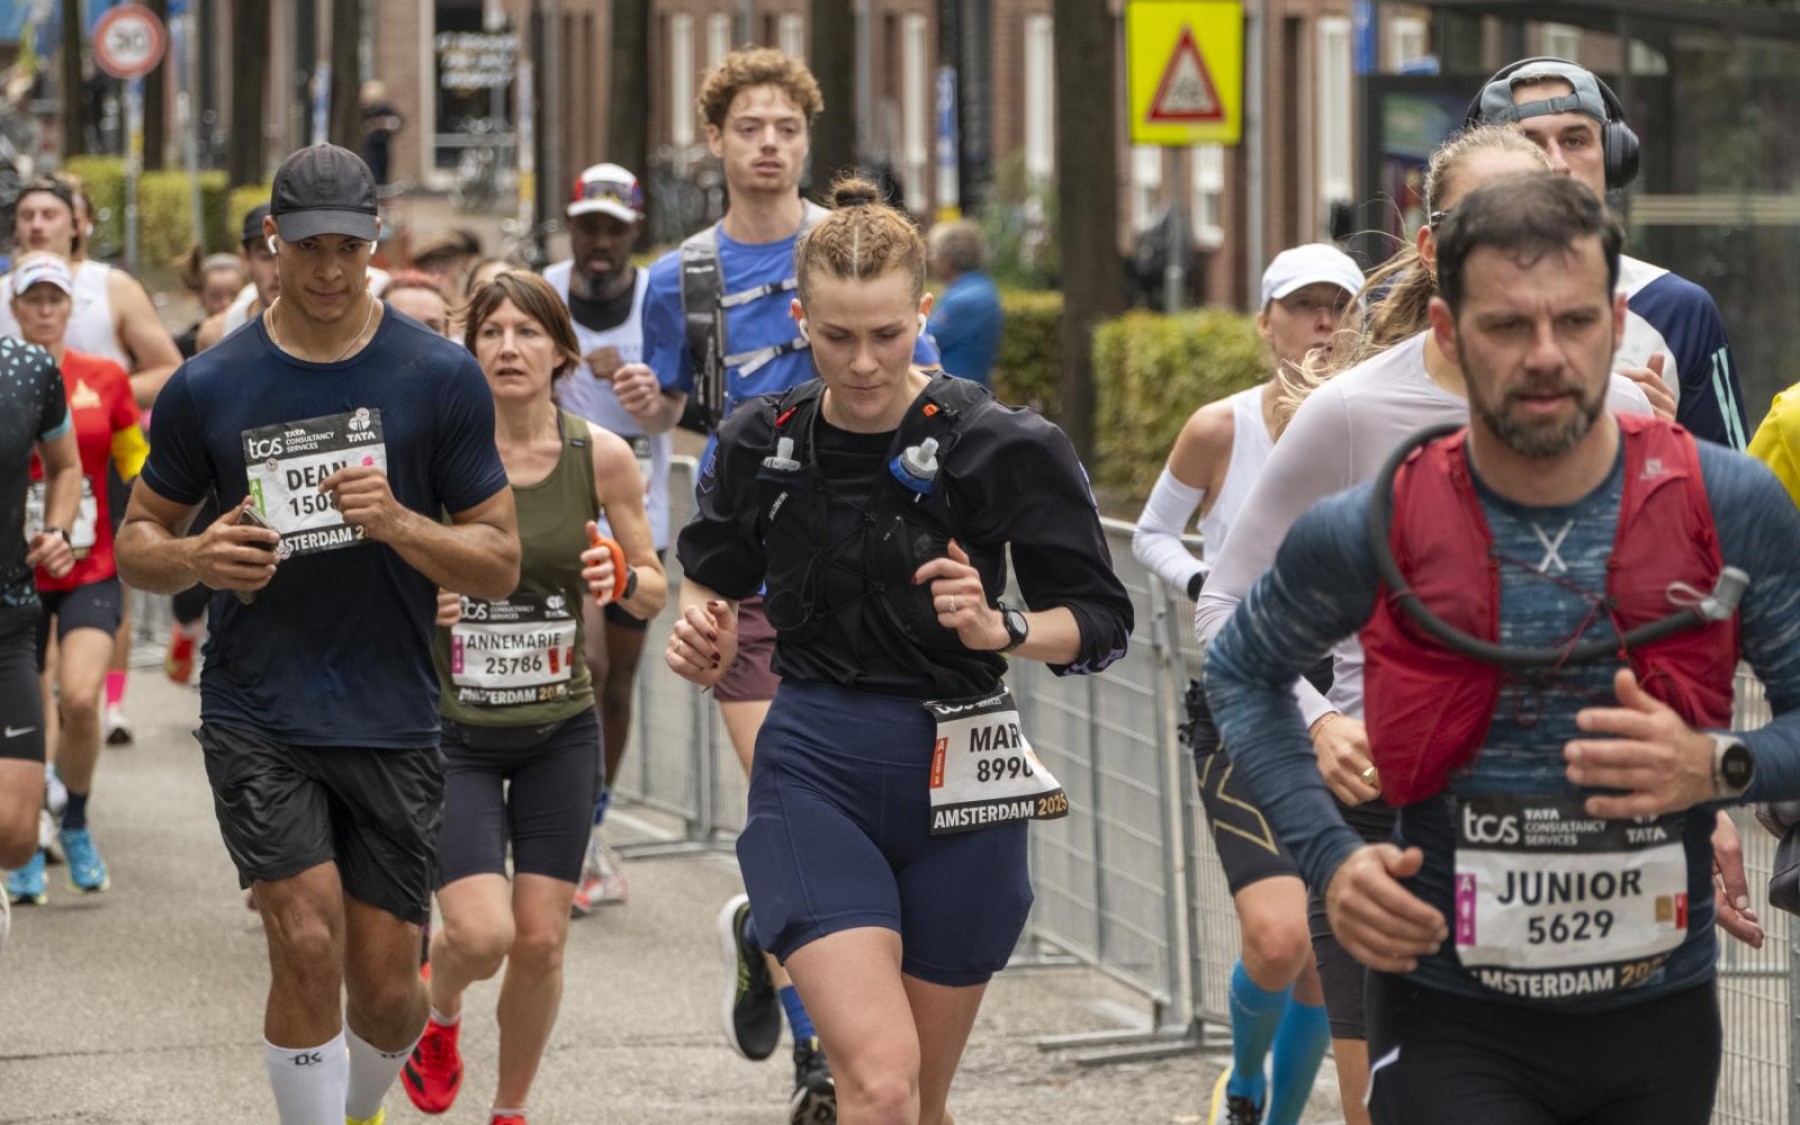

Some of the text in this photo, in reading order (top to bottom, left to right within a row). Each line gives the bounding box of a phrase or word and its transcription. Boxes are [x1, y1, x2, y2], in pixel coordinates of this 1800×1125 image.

[284, 429, 306, 437] TATA
[285, 431, 335, 445] CONSULTANCY
[346, 431, 377, 444] TATA
[248, 437, 283, 460] tcs
[286, 442, 319, 453] SERVICES
[467, 632, 562, 650] ANNEMARIE
[486, 655, 542, 675] 25786
[933, 793, 1068, 829] AMSTERDAM 2025
[1524, 809, 1559, 820] TATA
[1464, 803, 1520, 845] tcs
[1524, 821, 1607, 834] CONSULTANCY
[1524, 834, 1577, 846] SERVICES
[1626, 827, 1668, 843] TATA
[1496, 869, 1643, 905] JUNIOR
[1528, 910, 1614, 944] 5629
[1470, 967, 1615, 998] MSTERDAM
